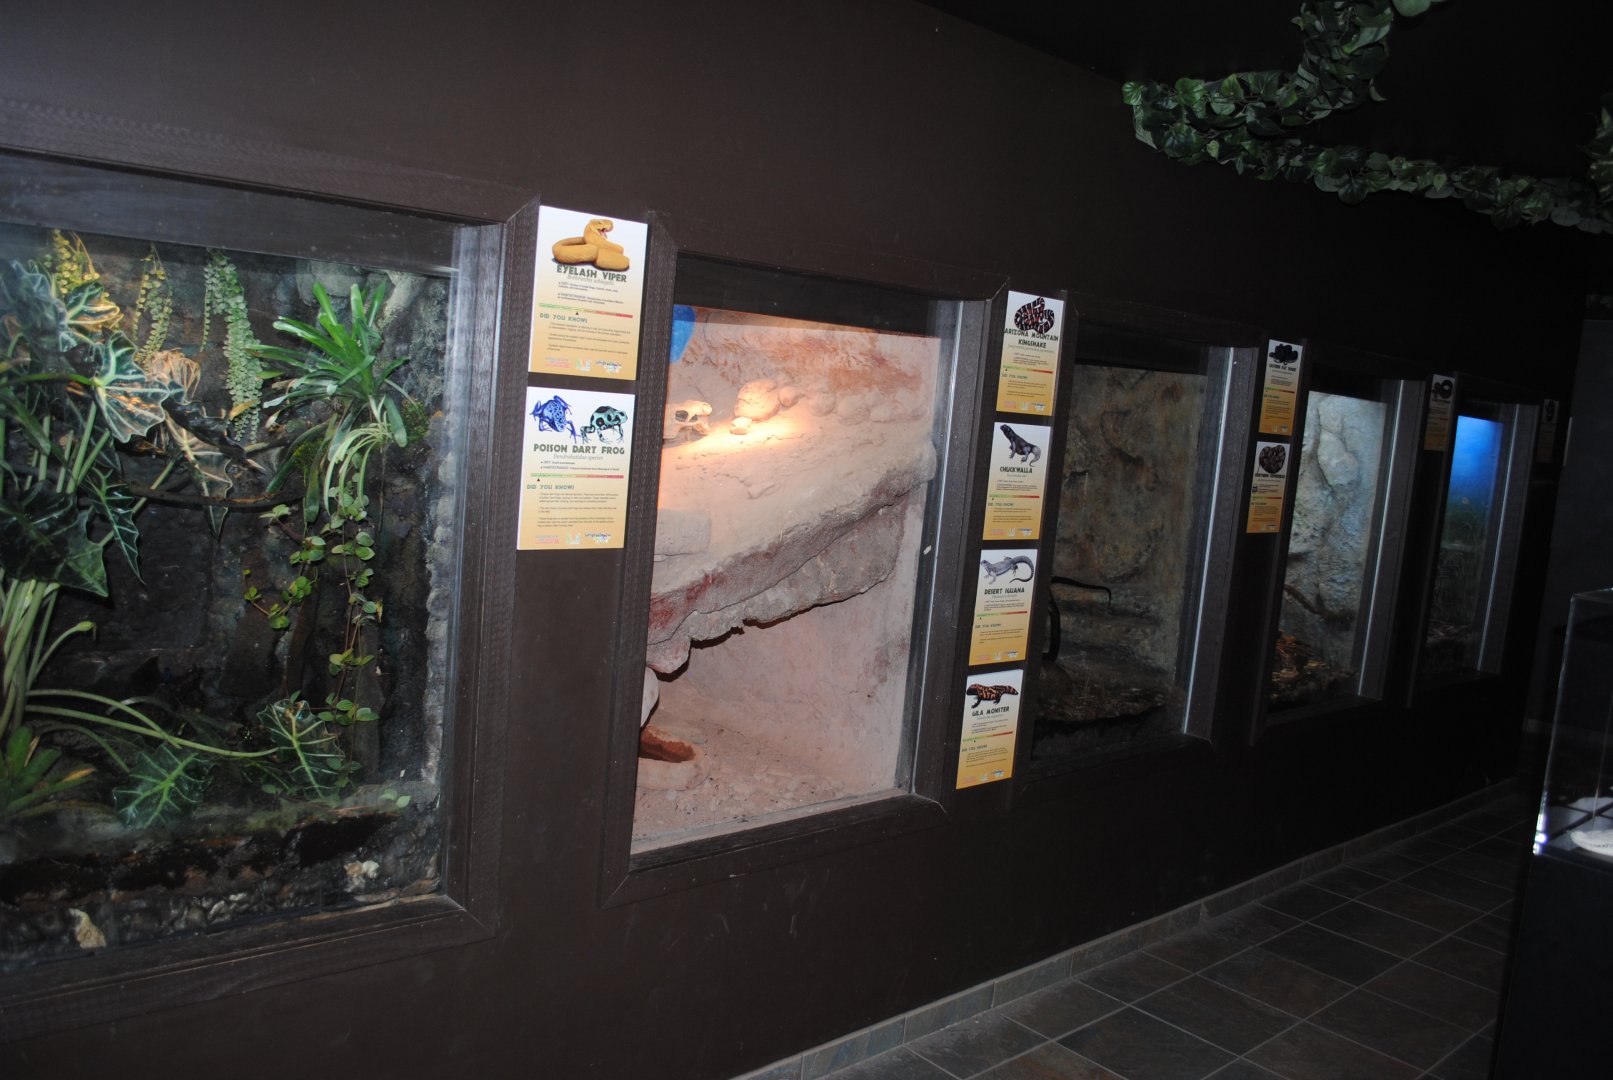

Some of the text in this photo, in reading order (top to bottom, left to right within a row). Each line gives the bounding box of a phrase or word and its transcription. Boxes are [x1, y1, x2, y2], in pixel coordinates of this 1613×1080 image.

[557, 264, 627, 282] EYELASH VIPER
[1004, 328, 1059, 341] ARIZONA MOUNTAIN
[1018, 339, 1046, 348] KINGSNAKE
[533, 444, 567, 452] POISON
[572, 445, 596, 454] DART
[986, 706, 1010, 715] MONSTER
